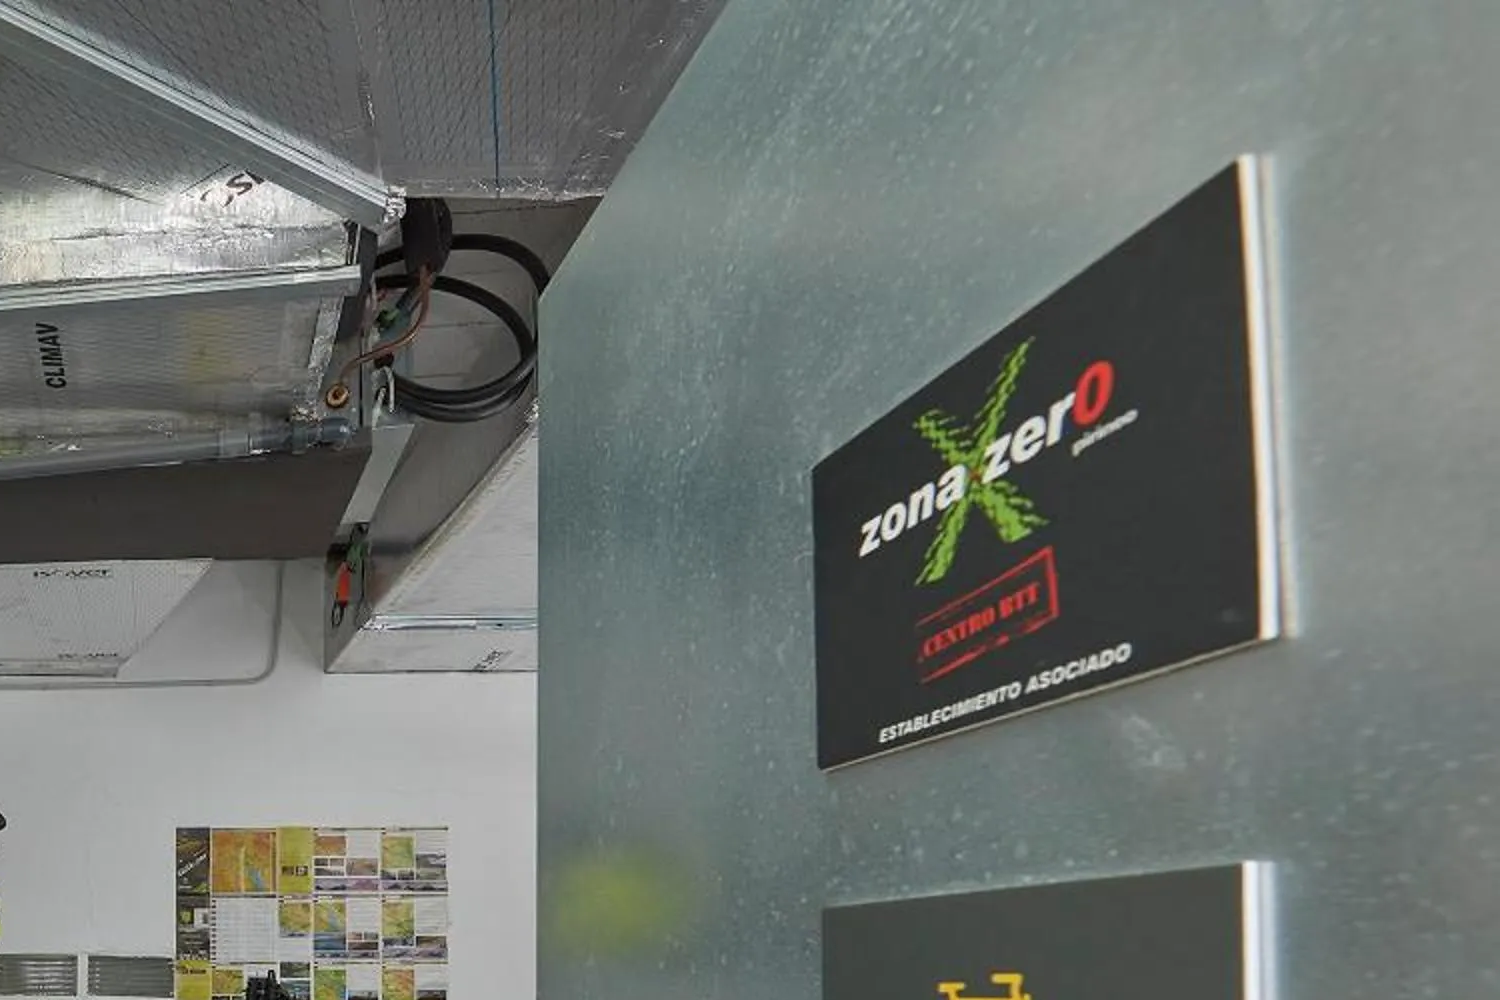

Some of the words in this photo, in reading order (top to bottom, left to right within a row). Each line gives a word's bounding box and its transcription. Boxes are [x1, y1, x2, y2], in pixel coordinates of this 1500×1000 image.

[859, 463, 967, 557] zona
[879, 681, 1023, 743] ESTABLECIMIENTO
[1024, 642, 1133, 694] ASOCIADO
